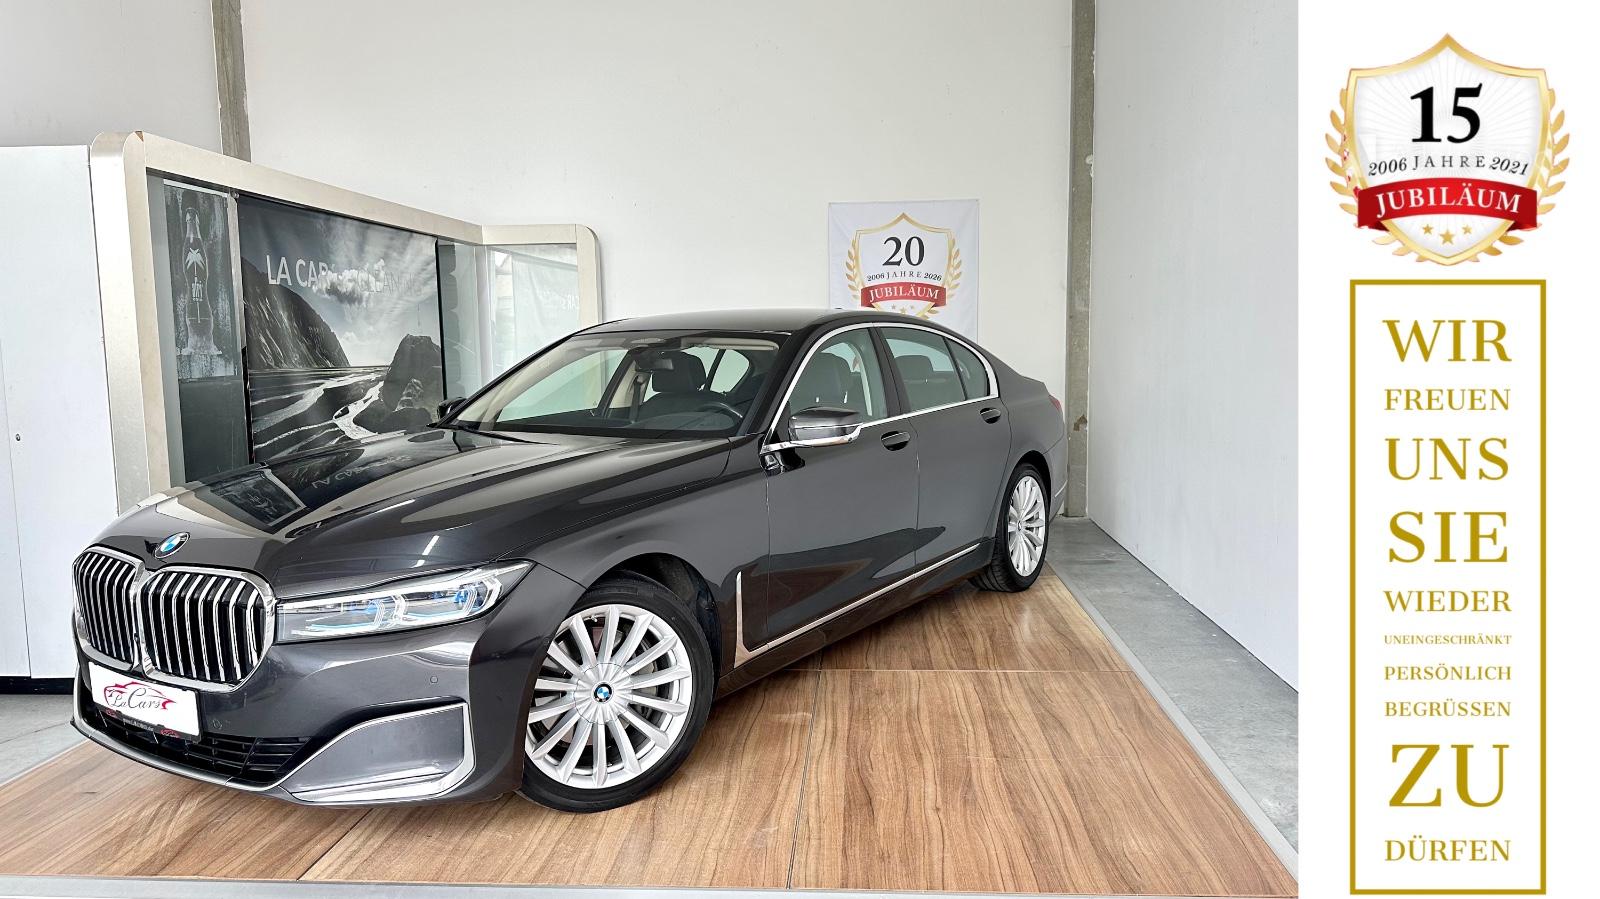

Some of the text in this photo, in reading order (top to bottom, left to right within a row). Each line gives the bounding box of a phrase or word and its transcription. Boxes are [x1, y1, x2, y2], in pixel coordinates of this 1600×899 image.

[882, 236, 925, 266] 20
[266, 254, 292, 286] LA
[867, 270, 942, 281] 2006 JAHRE 2026
[869, 284, 940, 303] JUBILÄUM
